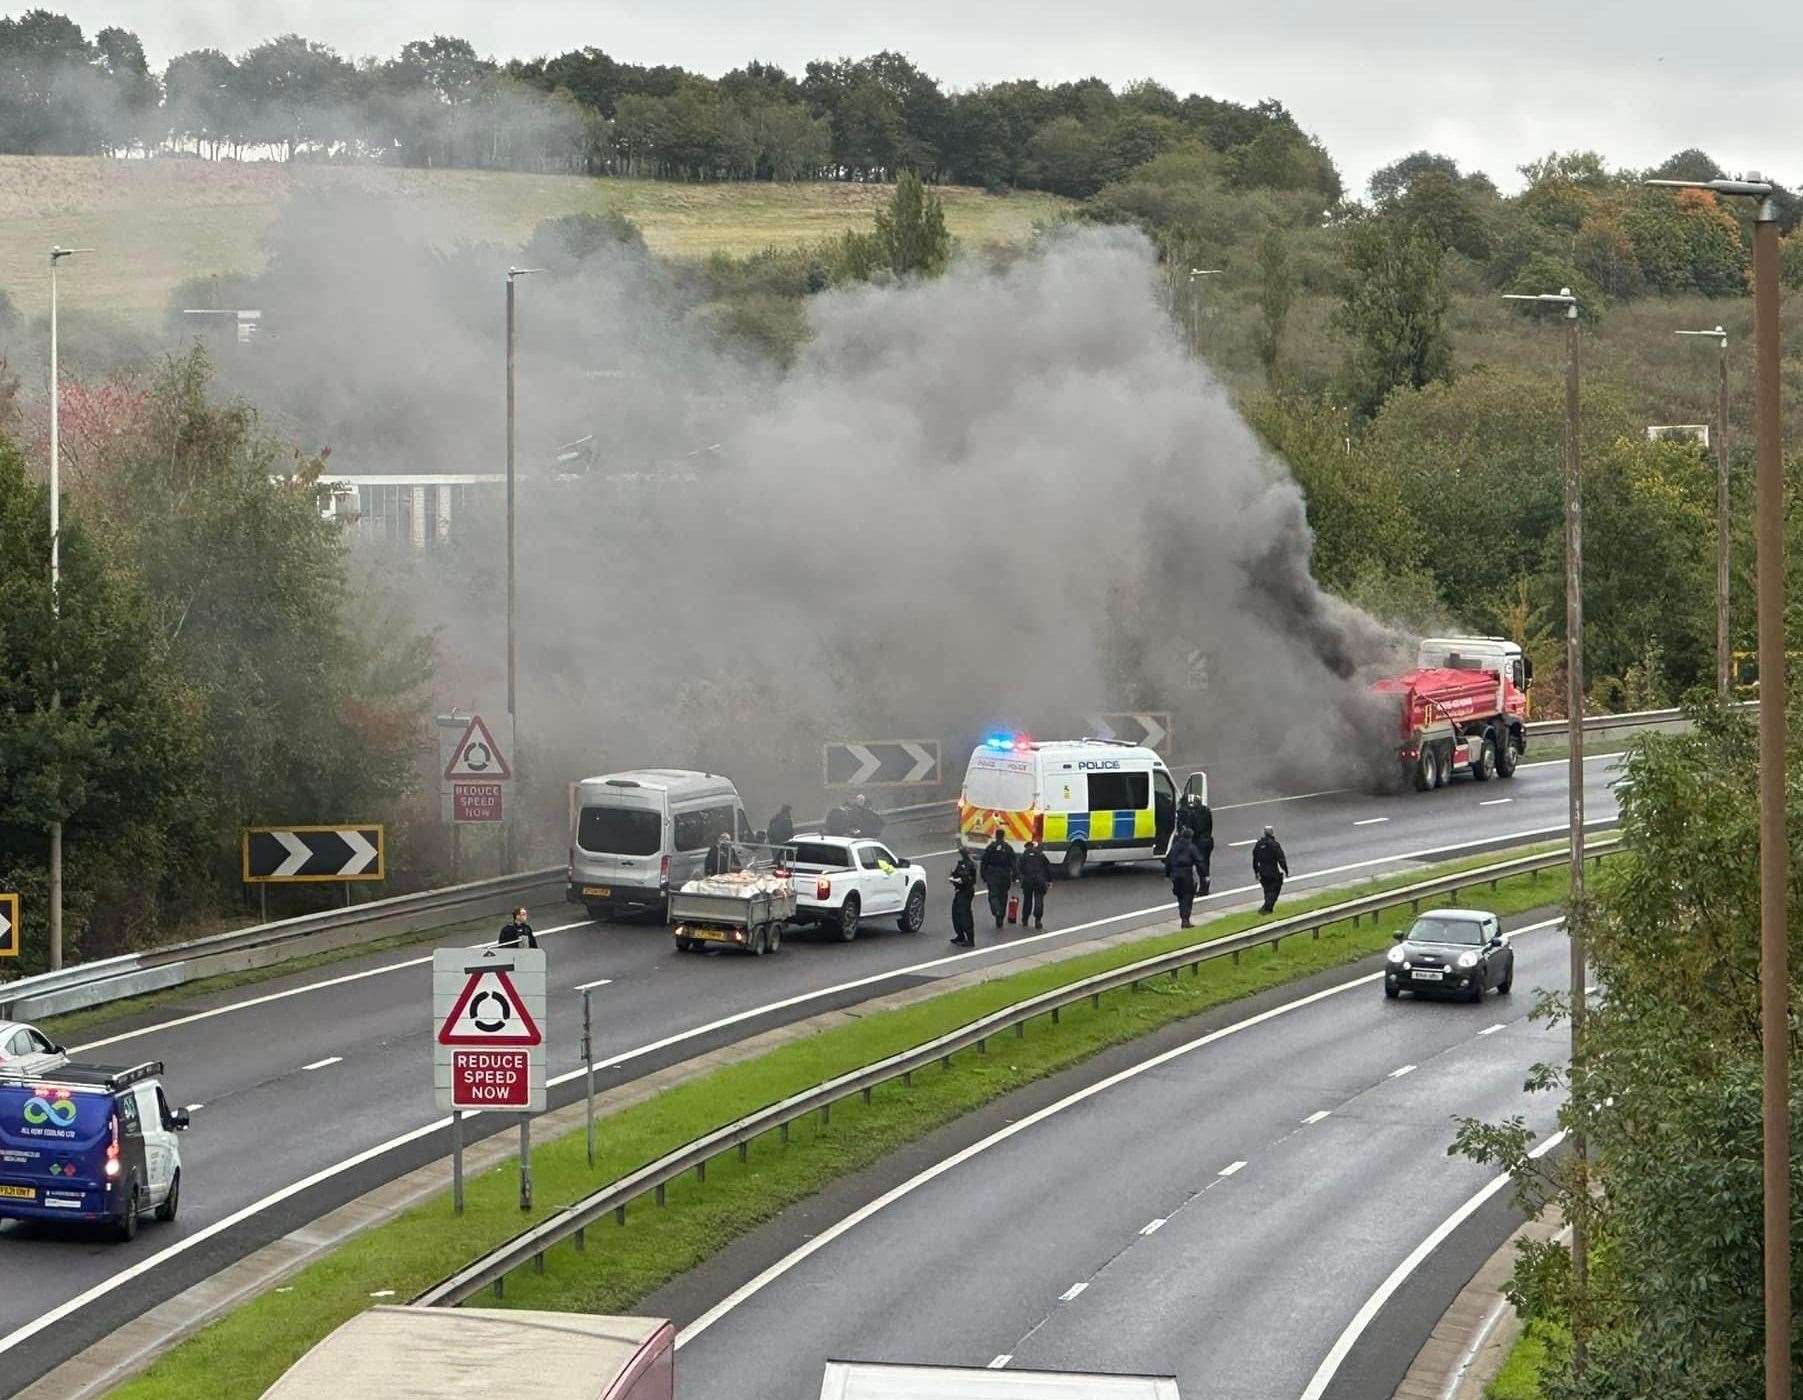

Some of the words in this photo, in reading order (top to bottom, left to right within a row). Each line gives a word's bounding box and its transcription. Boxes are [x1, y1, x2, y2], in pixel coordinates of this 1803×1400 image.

[1078, 760, 1121, 770] POLICE
[455, 786, 500, 796] REDUCE
[460, 796, 495, 806] SPEED
[465, 808, 490, 817] NOW
[457, 1055, 524, 1069] REDUCE
[464, 1070, 517, 1084] SPEED
[471, 1086, 510, 1099] NOW
